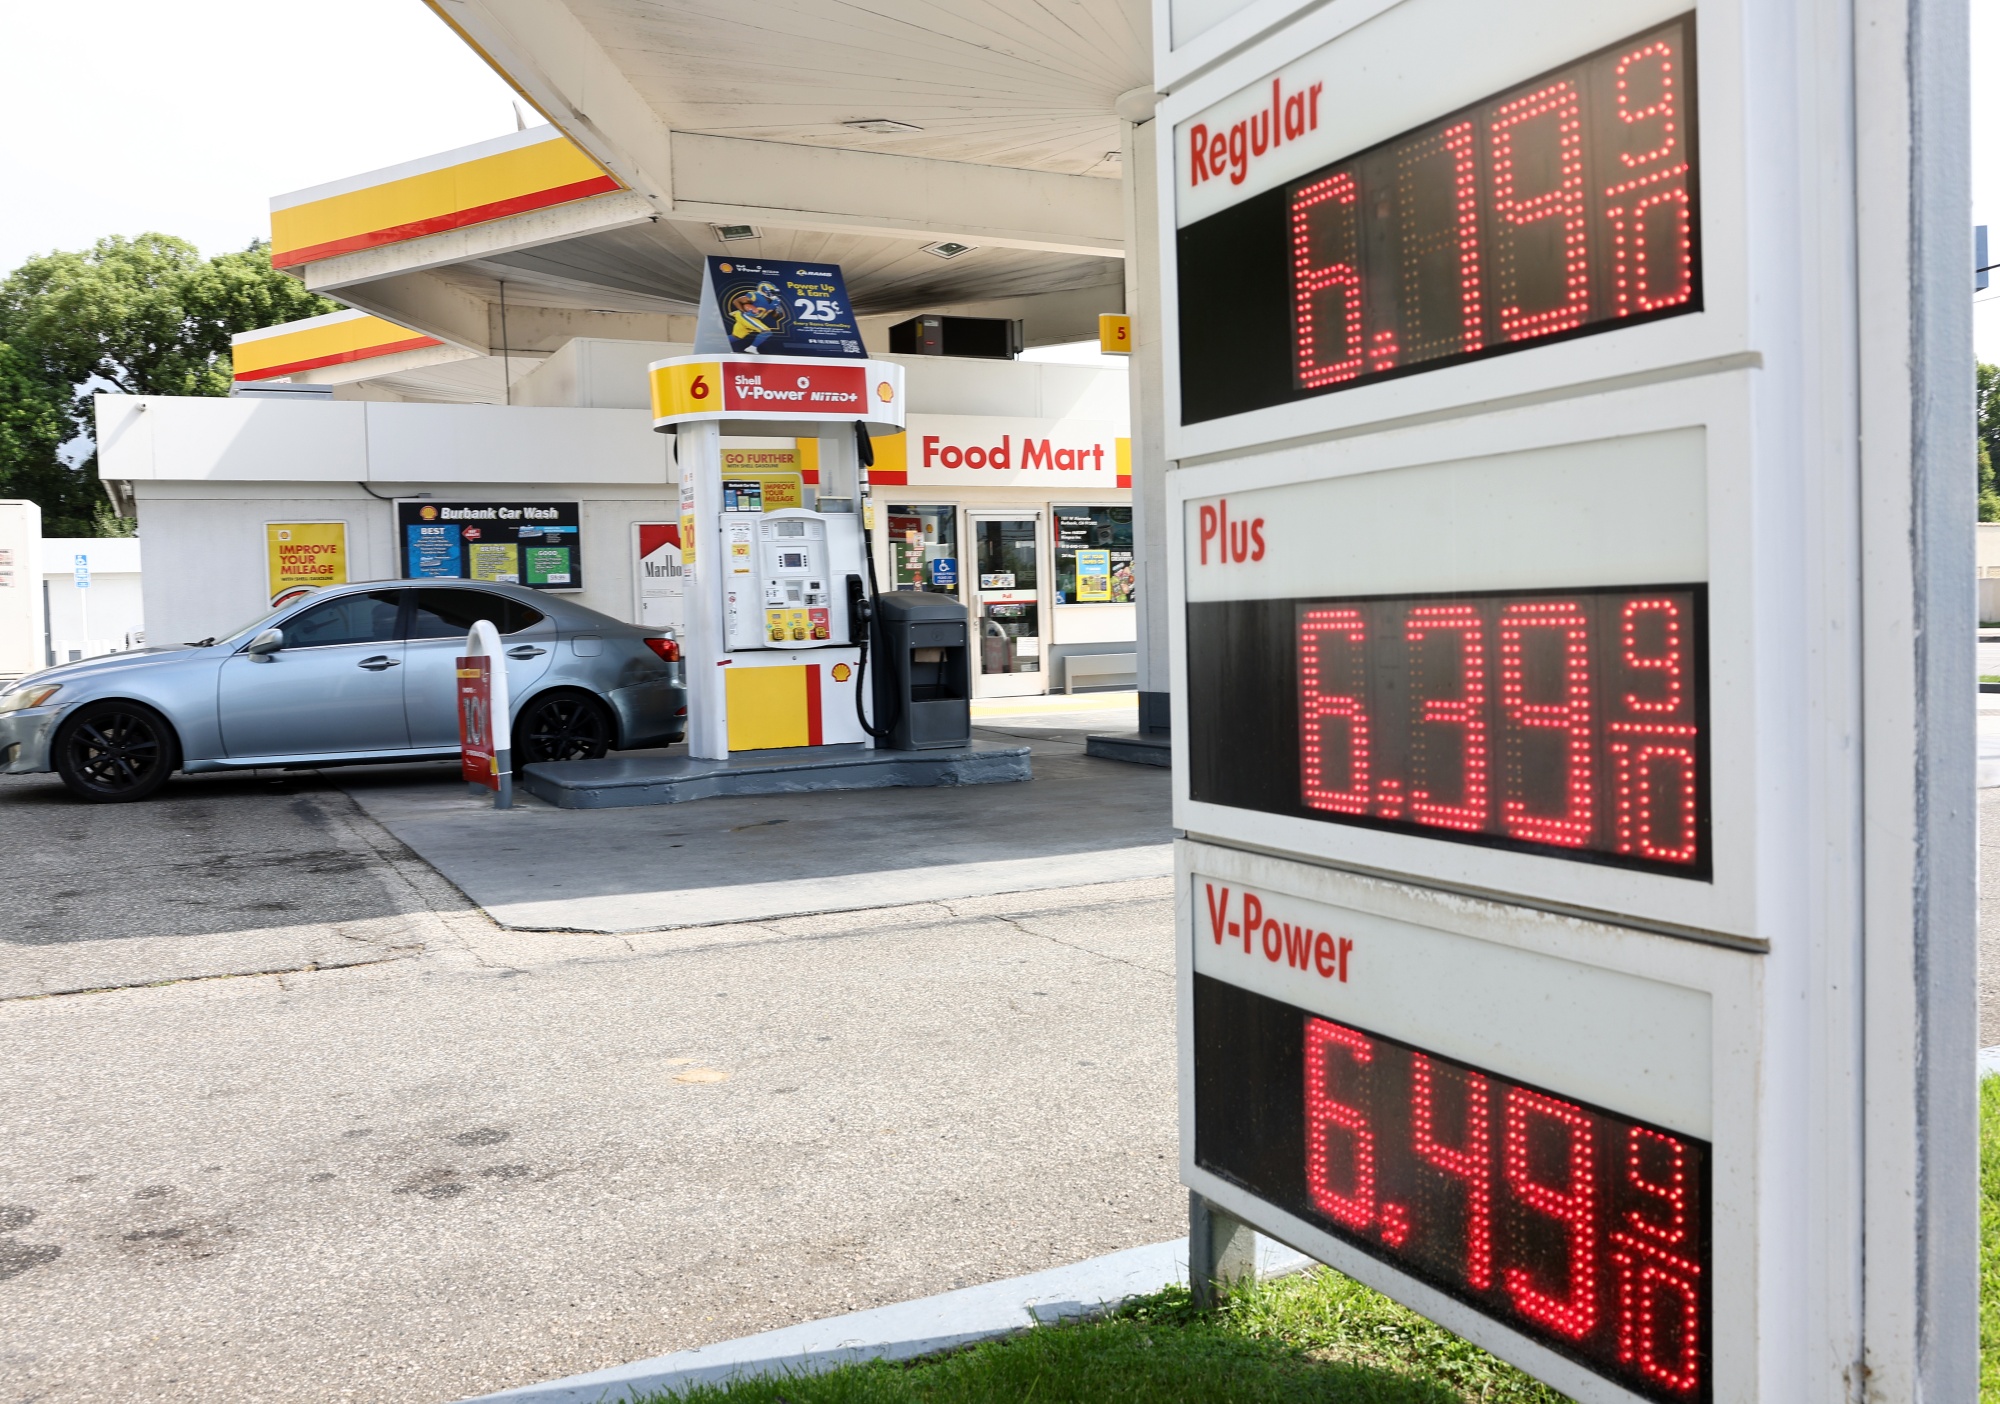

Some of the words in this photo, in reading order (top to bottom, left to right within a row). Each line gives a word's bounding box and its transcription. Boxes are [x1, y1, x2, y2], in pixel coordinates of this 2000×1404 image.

[1190, 79, 1323, 185] Regular
[1291, 81, 1588, 387] 6.19
[786, 281, 819, 290] Power
[820, 283, 835, 293] Up
[797, 288, 806, 296] &
[807, 289, 830, 297] Earn
[794, 298, 840, 322] 25¢
[1117, 326, 1127, 340] 5
[735, 375, 762, 385] Shell
[690, 375, 709, 400] 6
[735, 386, 805, 400] V-Power
[725, 453, 744, 463] GO
[747, 453, 794, 463] FURTHER
[923, 435, 1011, 470] Food
[1021, 438, 1105, 471] Mart
[440, 507, 498, 519] Burbank
[498, 507, 522, 519] Car
[523, 507, 559, 519] Wash
[421, 527, 446, 535] BEST
[1200, 499, 1265, 565] Plus
[279, 544, 337, 554] IMPROVE
[279, 555, 316, 564] YOUR
[280, 565, 335, 574] MILEAGE
[1302, 603, 1593, 846] 6.39
[1206, 883, 1353, 983] V-Power
[1307, 1017, 1596, 1339] 6.49
